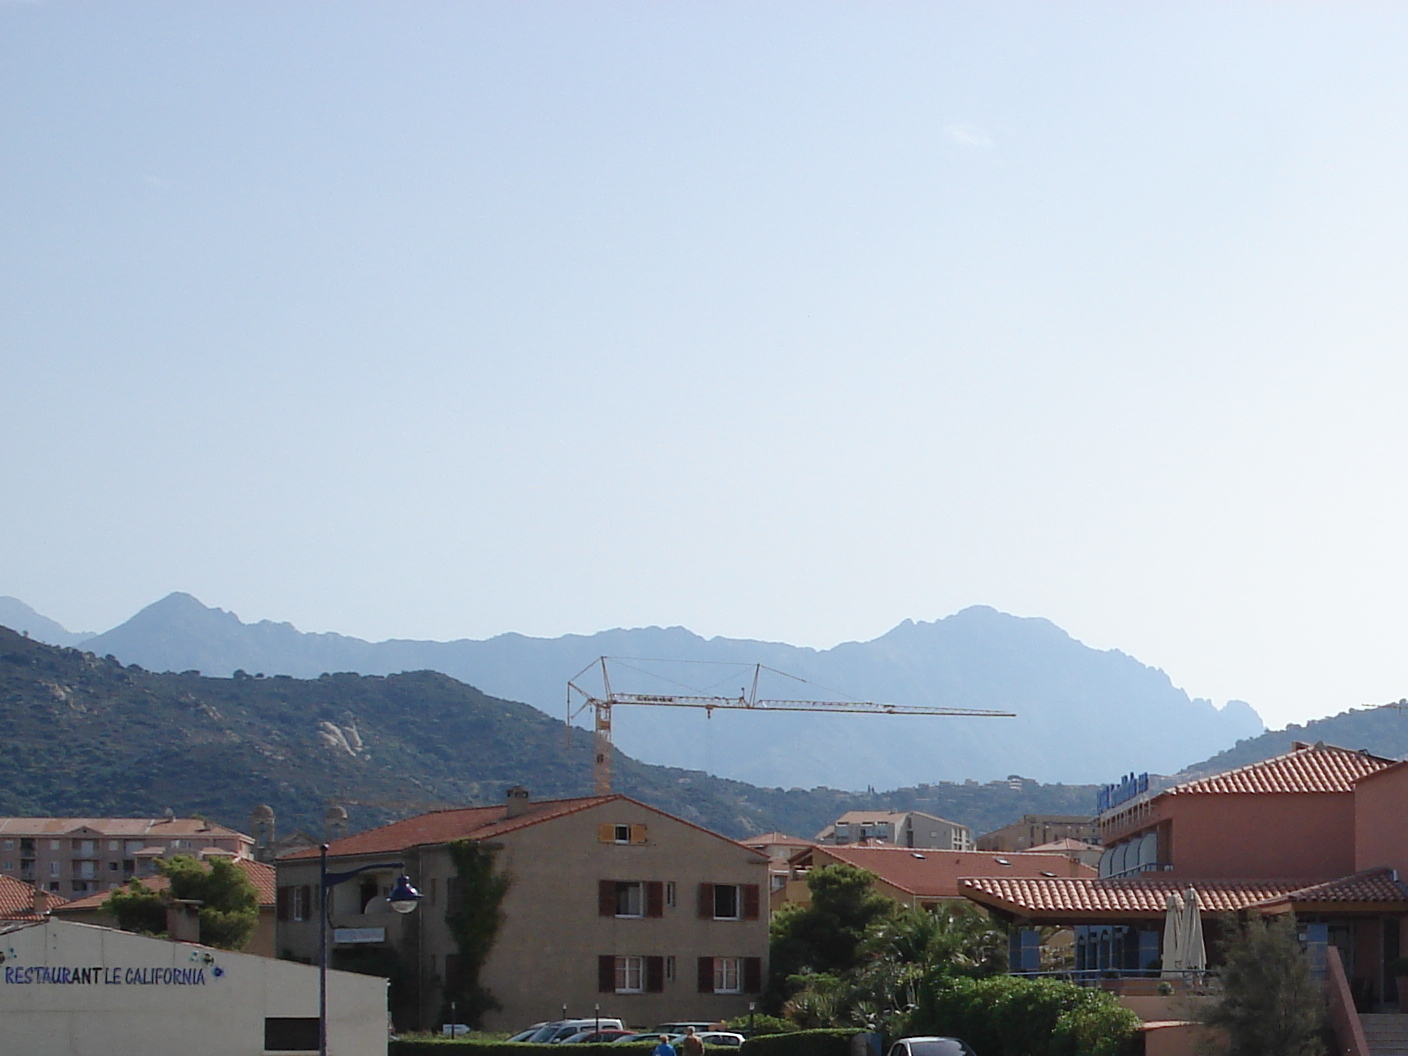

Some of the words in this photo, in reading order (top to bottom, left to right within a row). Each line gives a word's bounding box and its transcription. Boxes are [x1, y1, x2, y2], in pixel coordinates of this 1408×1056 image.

[5, 967, 103, 985] RESTAURANT
[105, 967, 121, 985] LE
[125, 967, 205, 985] CALIFORNIA
